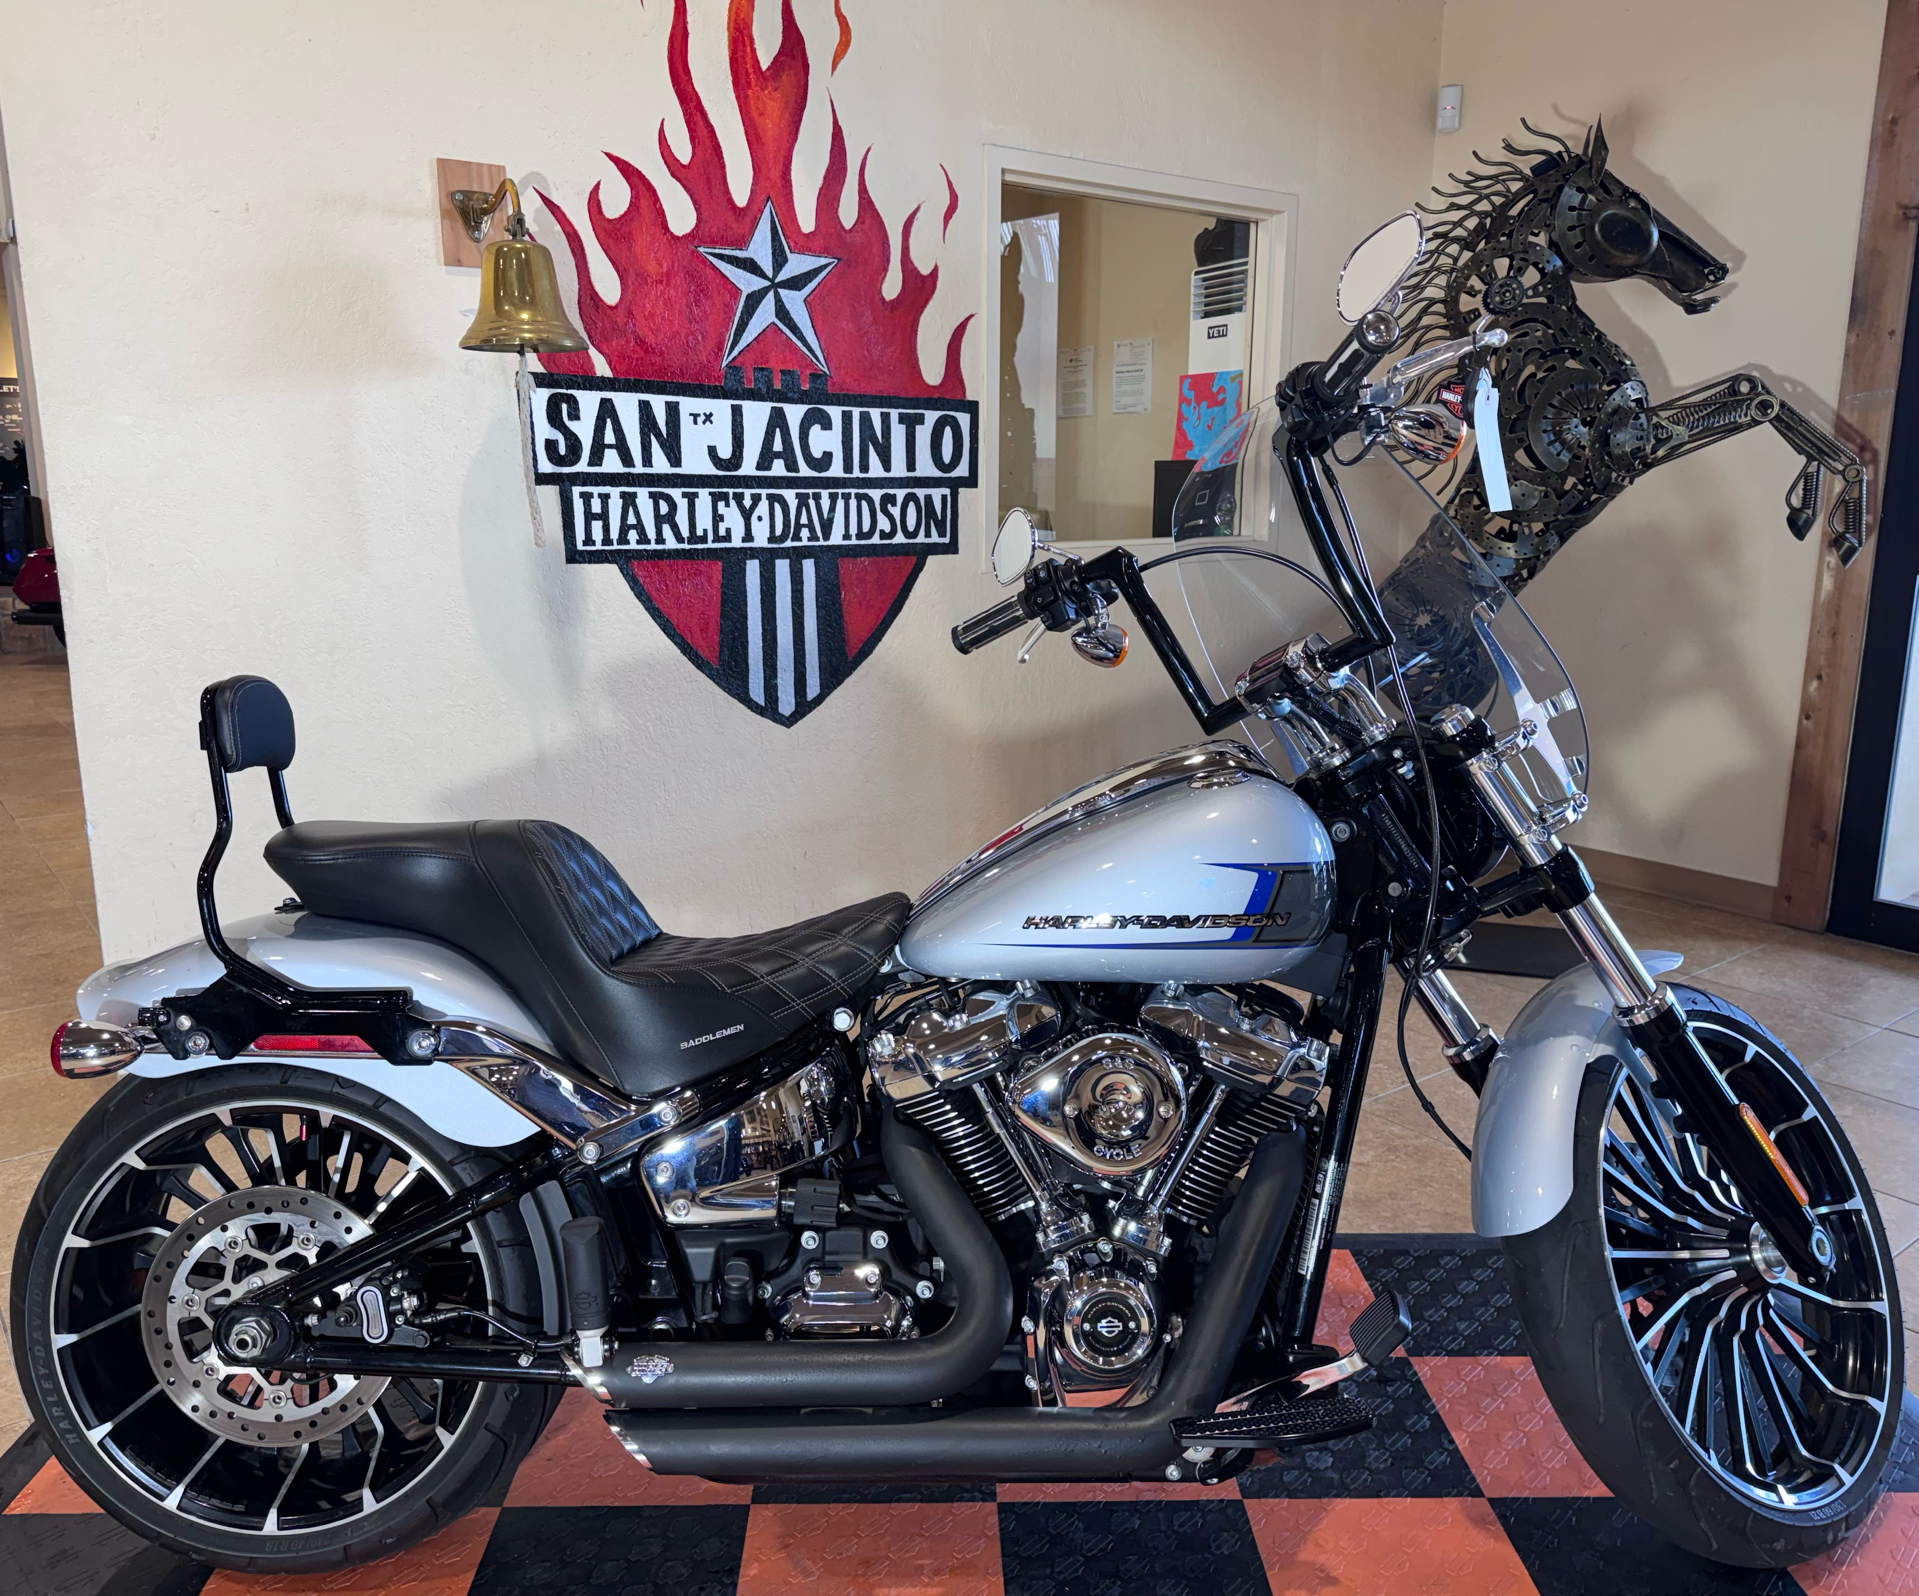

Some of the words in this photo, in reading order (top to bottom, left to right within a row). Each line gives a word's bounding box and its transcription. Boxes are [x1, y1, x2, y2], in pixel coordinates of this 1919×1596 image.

[1208, 326, 1227, 338] YETI
[543, 392, 682, 468] SAN
[689, 412, 714, 426] TX
[707, 403, 964, 474] JACINTO
[1022, 911, 1291, 930] HARLEY-DAVIDSON
[680, 1023, 744, 1050] SADDLEMEN
[1093, 1144, 1142, 1161] CYCLE
